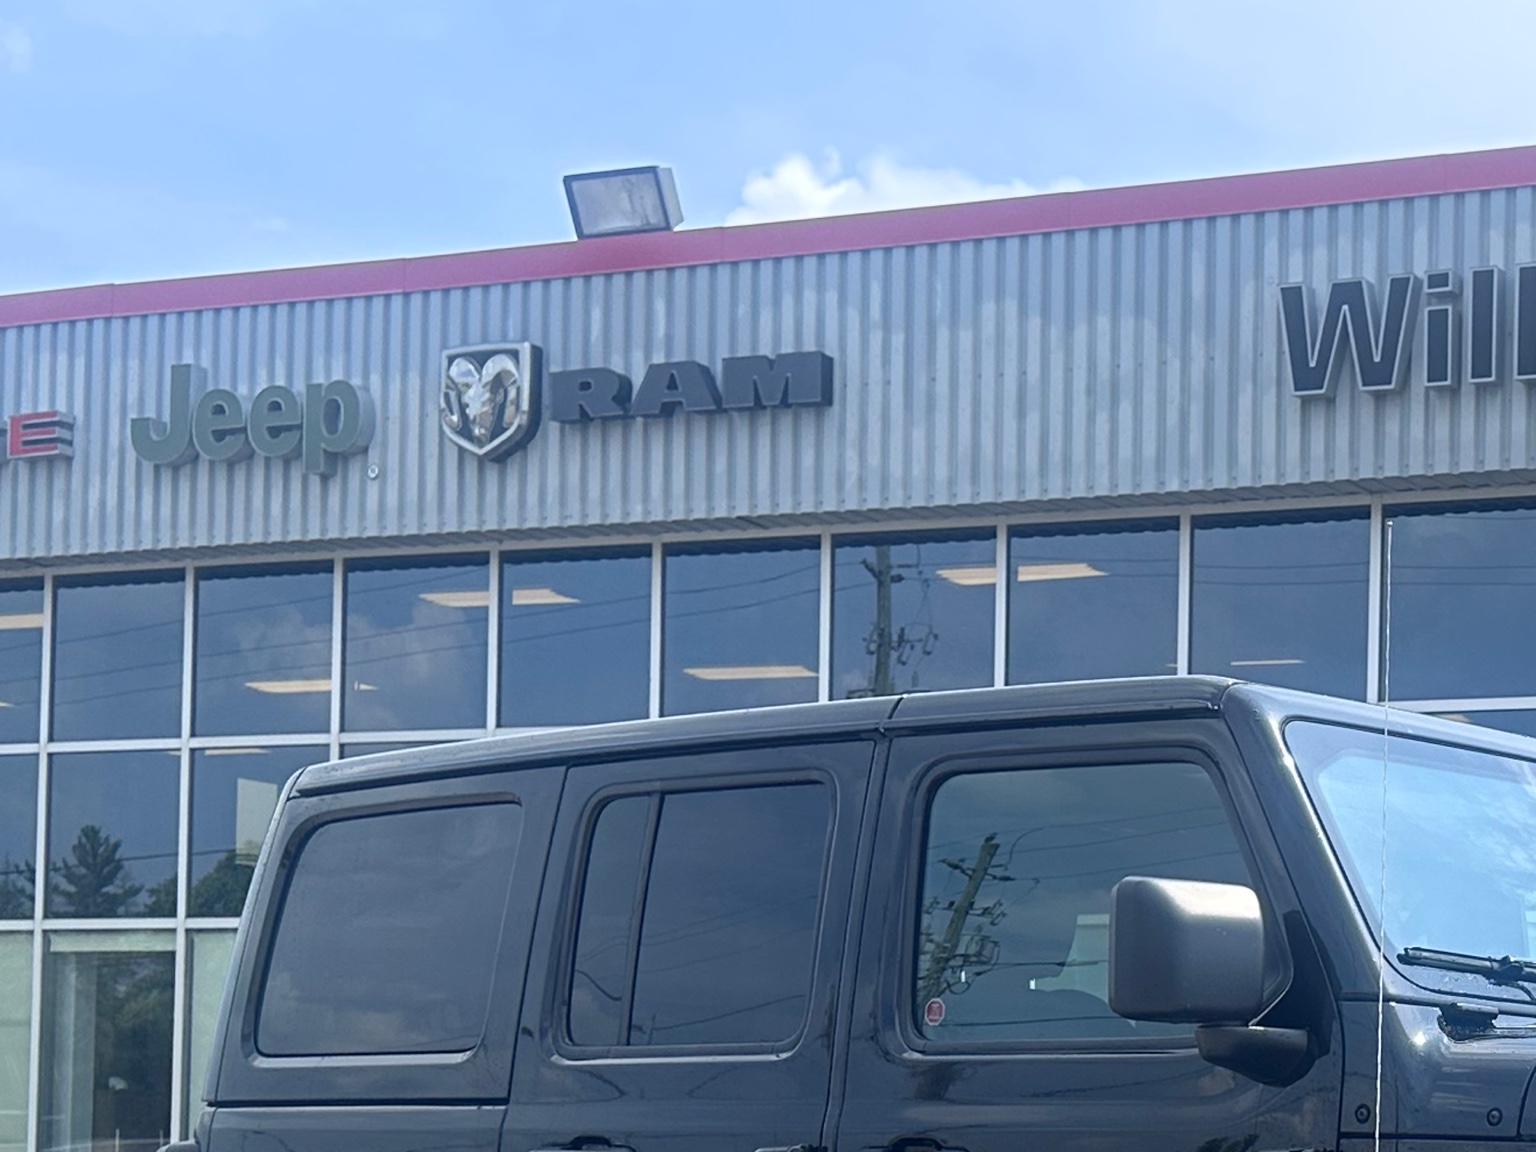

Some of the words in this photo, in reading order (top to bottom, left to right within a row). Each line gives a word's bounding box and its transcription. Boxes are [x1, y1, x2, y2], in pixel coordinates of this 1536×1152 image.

[130, 363, 376, 477] Jeep
[549, 351, 834, 424] RAM
[0, 408, 76, 460] E
